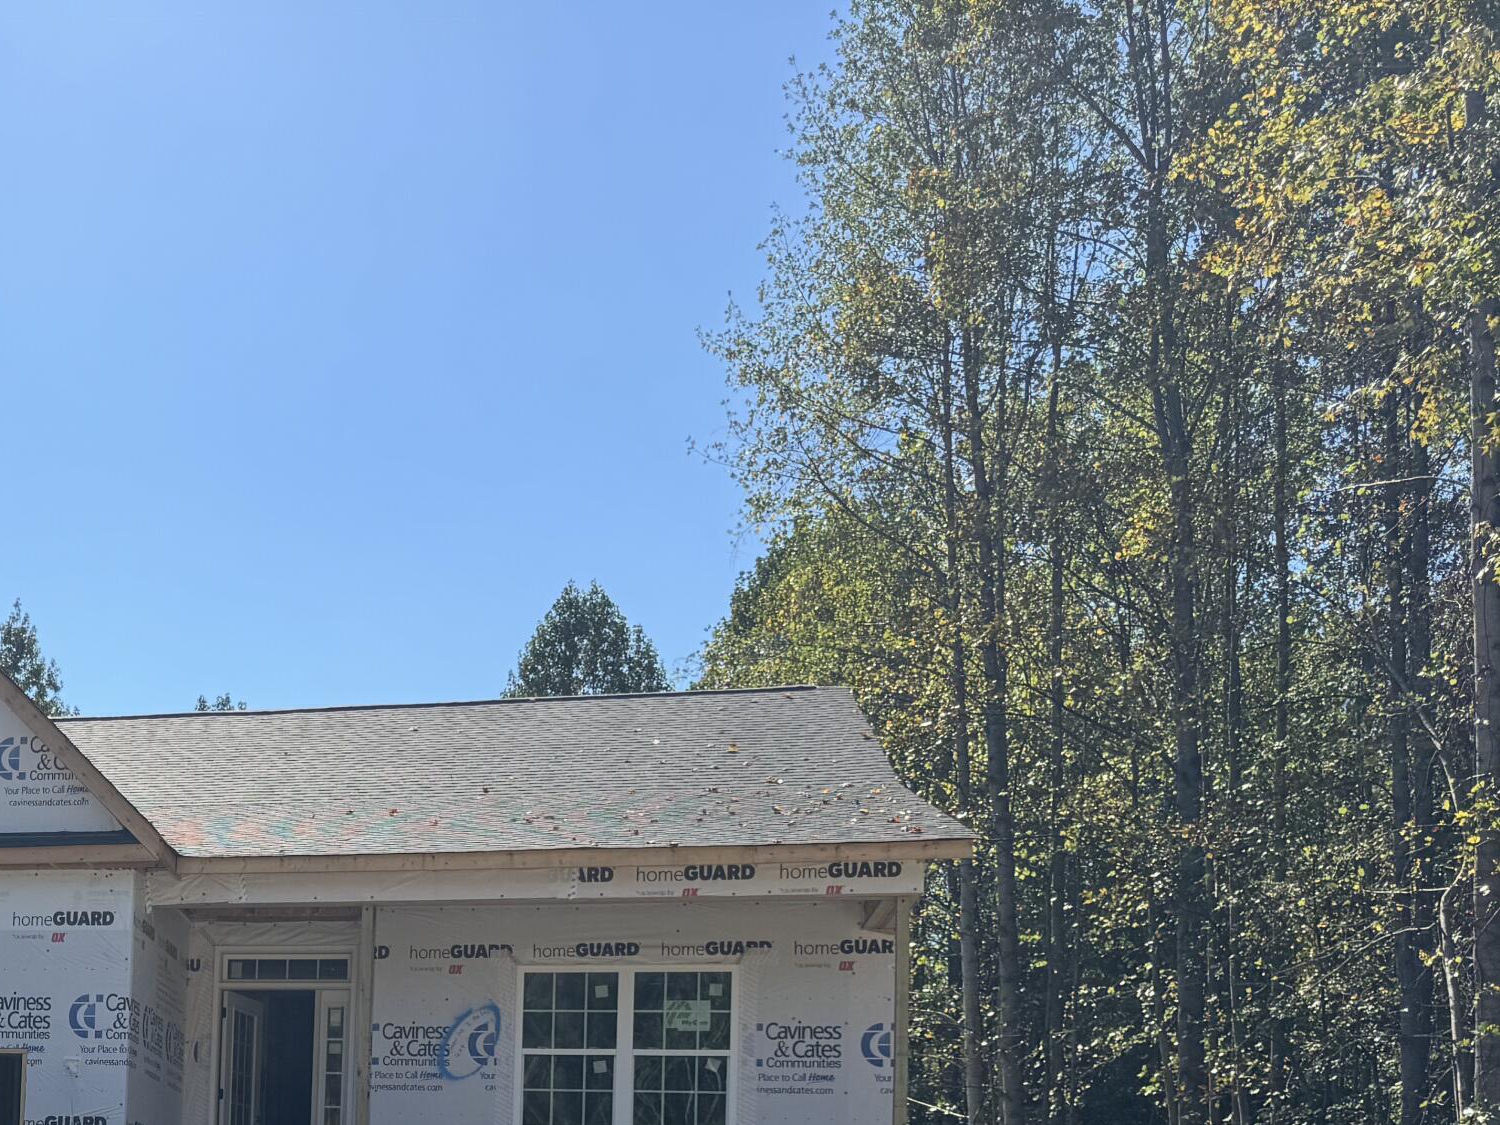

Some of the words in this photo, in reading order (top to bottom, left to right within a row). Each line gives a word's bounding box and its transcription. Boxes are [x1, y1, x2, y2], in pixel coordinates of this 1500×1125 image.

[636, 864, 756, 882] homeGUARD
[779, 861, 902, 879] homeGUARD
[12, 910, 115, 927] homeGUARD
[533, 942, 640, 958] homeGUARD
[7, 1011, 51, 1030] Cates
[113, 1012, 129, 1029] &
[765, 1020, 842, 1040] Caviness
[389, 1040, 405, 1057] &
[773, 1040, 790, 1057] &
[792, 1039, 842, 1059] Cates
[765, 1057, 842, 1069] Communities
[395, 1071, 404, 1079] to
[405, 1071, 418, 1079] Call
[757, 1072, 779, 1082] Place
[781, 1073, 790, 1082] to
[791, 1072, 806, 1082] Call
[808, 1072, 836, 1084] Home
